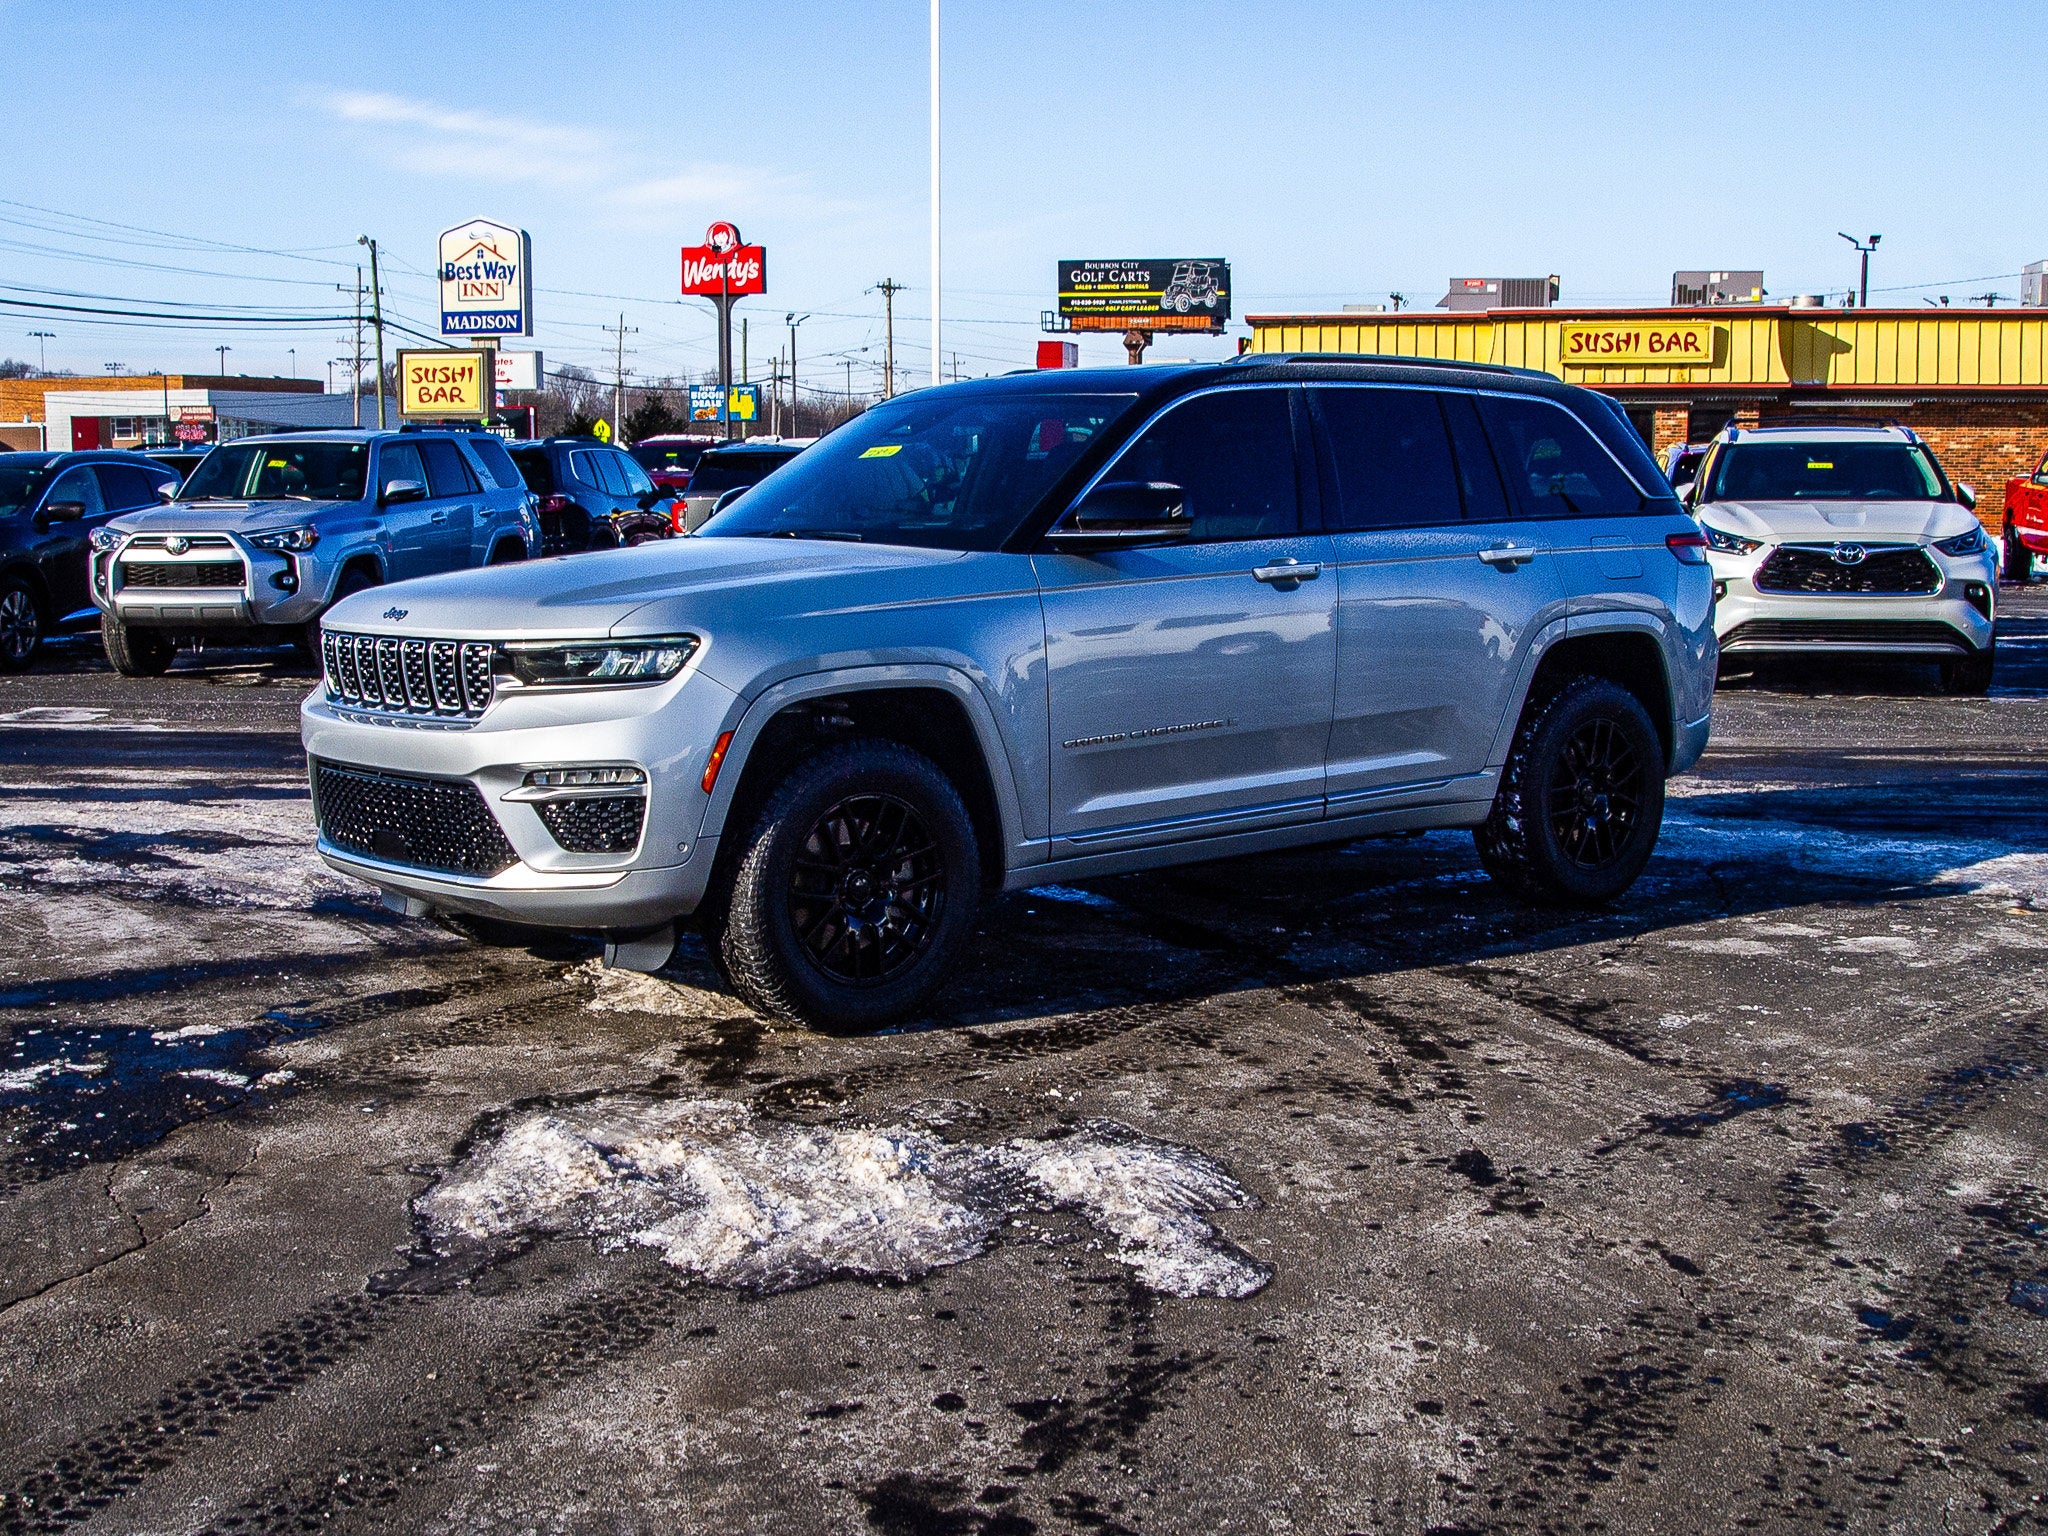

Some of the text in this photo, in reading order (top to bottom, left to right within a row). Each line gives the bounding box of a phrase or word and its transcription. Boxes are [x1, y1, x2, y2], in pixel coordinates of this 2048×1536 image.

[445, 261, 516, 285] Best Way
[683, 252, 760, 288] Wendy's
[1121, 261, 1139, 269] CITY
[1070, 270, 1150, 283] GOLF CARTS
[463, 282, 499, 296] INN
[446, 314, 518, 330] MADISON
[1569, 331, 1702, 354] SUSHI BAR
[411, 366, 473, 384] SUSHI
[418, 386, 466, 404] BAR
[382, 606, 409, 622] Jeep
[1062, 732, 1127, 749] GRAND
[1129, 719, 1225, 740] CHEROKEE
